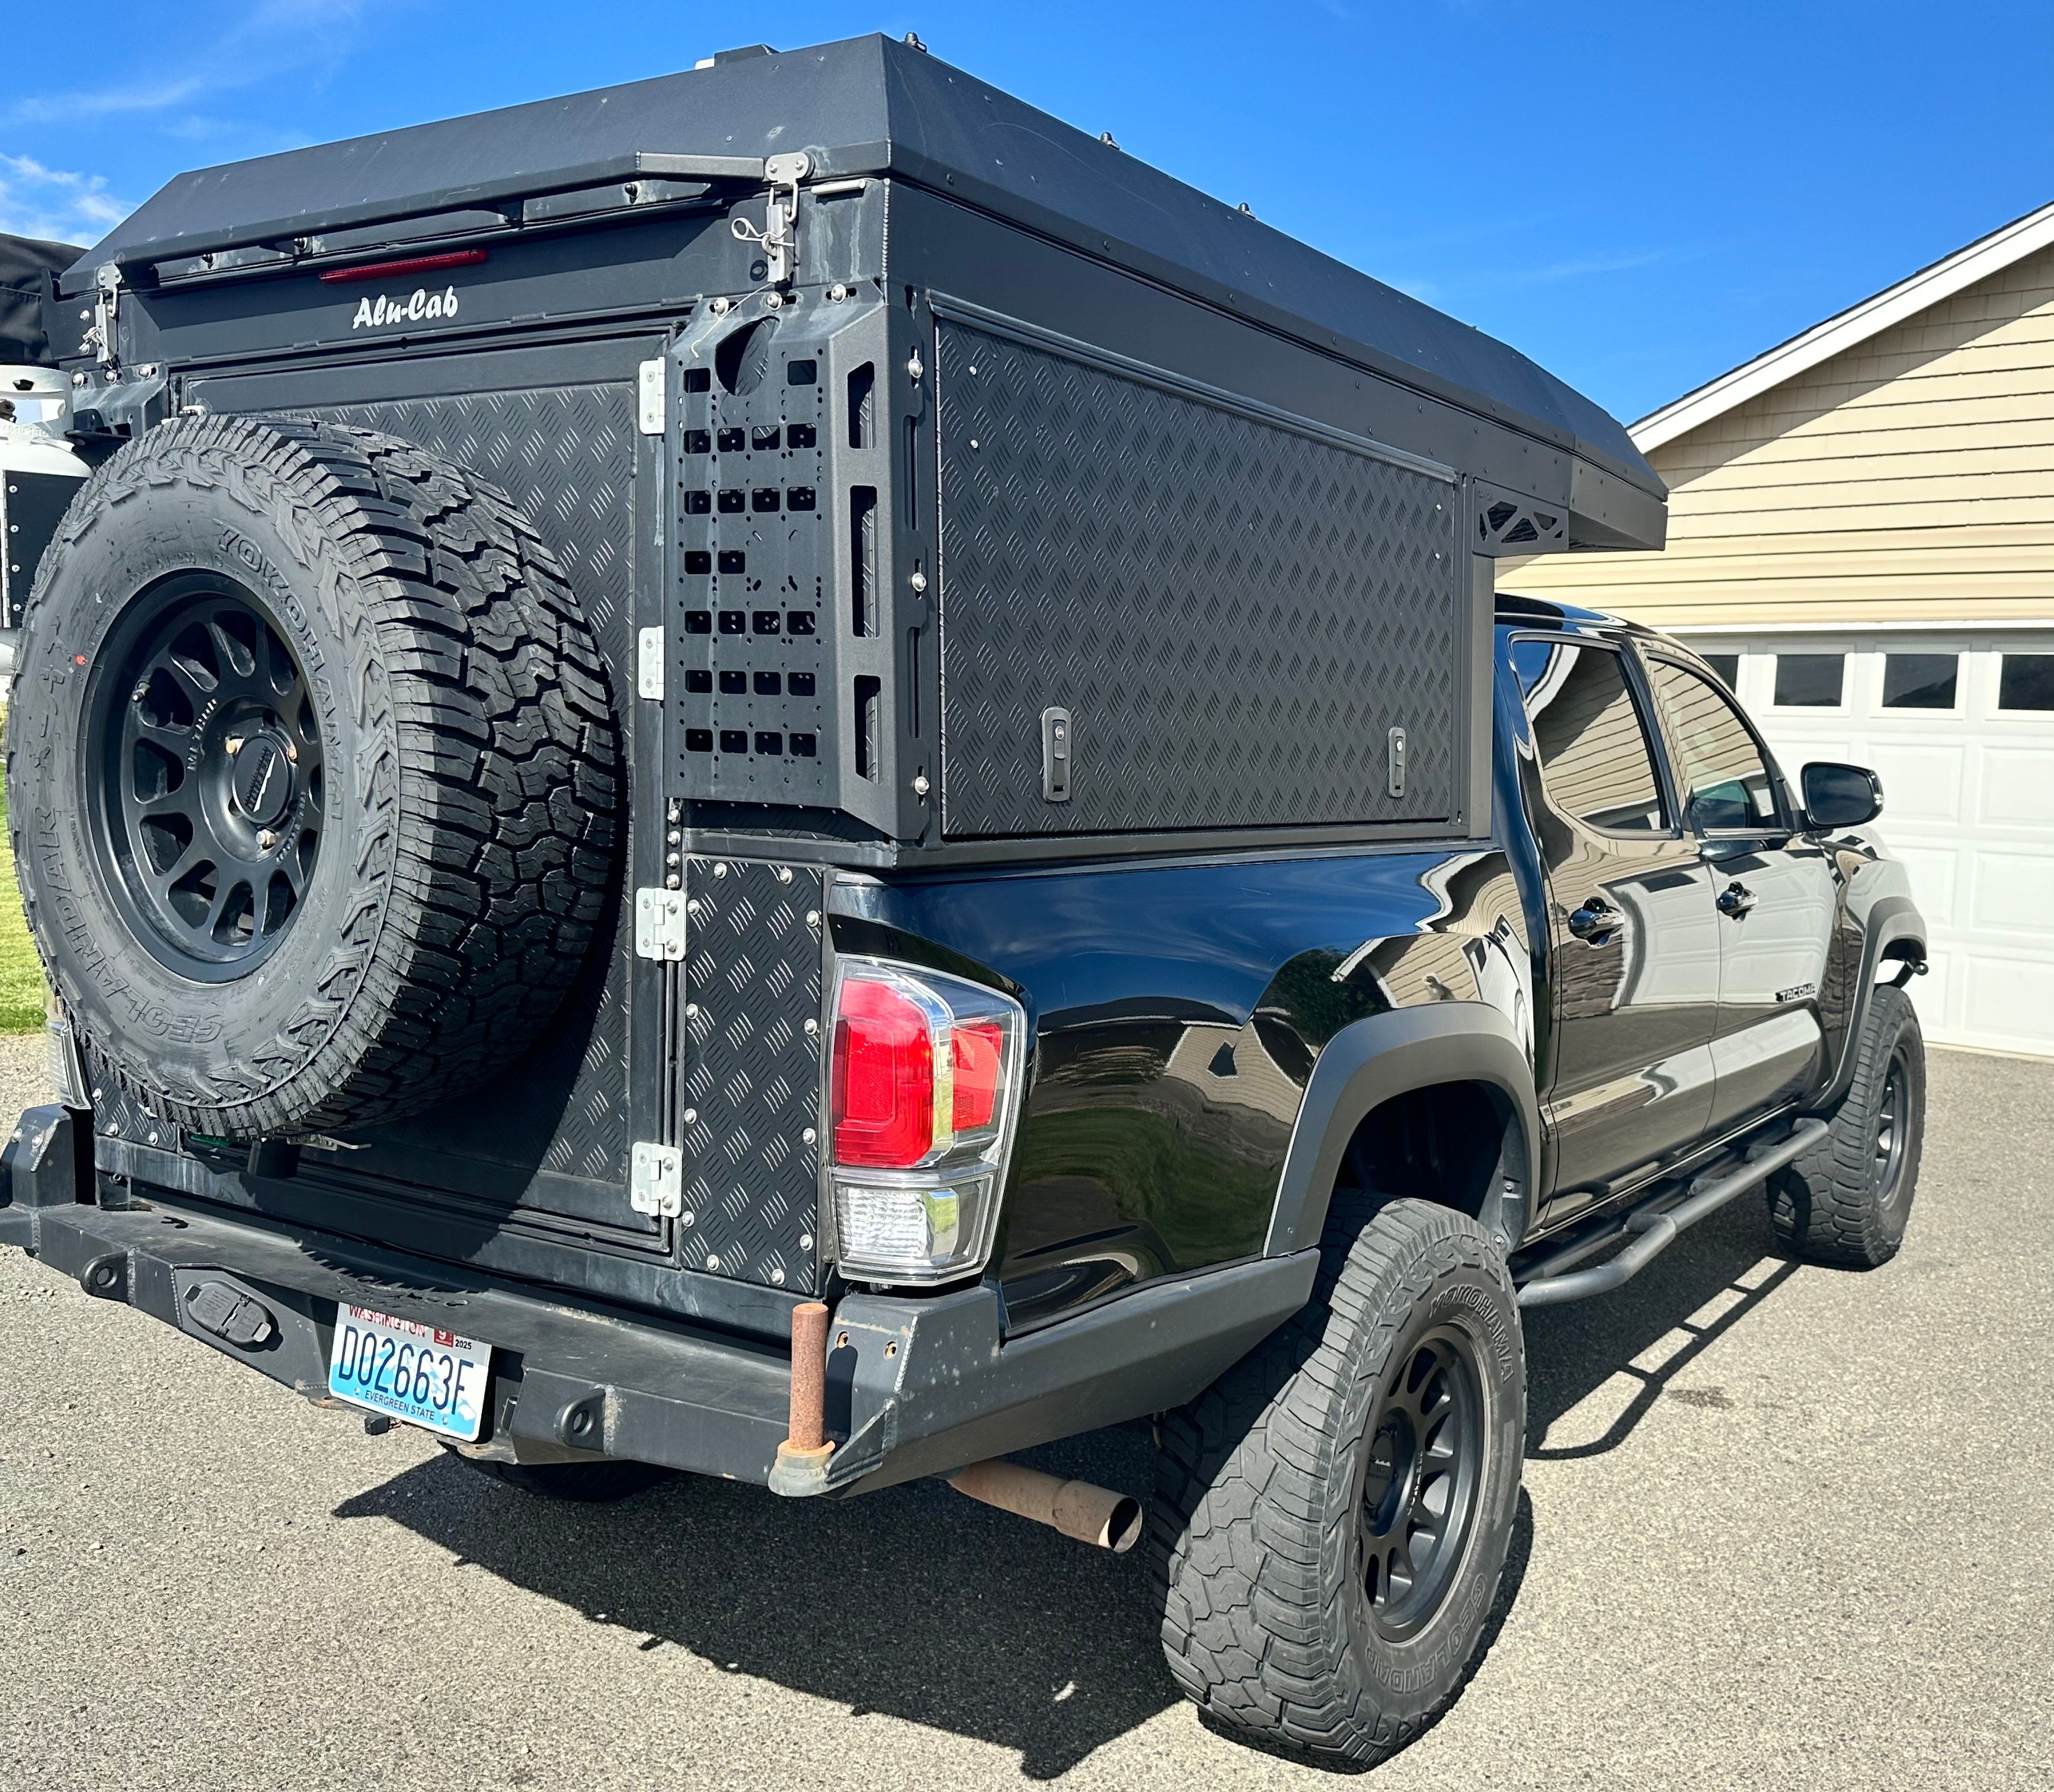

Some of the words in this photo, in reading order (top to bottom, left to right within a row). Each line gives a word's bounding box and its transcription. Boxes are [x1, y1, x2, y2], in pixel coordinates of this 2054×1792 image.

[353, 286, 458, 329] Alu-Cab
[212, 518, 344, 820] YOKOHAMA
[34, 807, 223, 1044] GEOLANDAR
[1778, 983, 1816, 1001] TACOMA
[338, 1325, 474, 1415] D02663F
[348, 1305, 425, 1337] WASHINGTON
[455, 1339, 472, 1350] 2025
[1428, 1284, 1514, 1384] YOKOHAMA
[364, 1390, 409, 1415] EVERGREEN
[410, 1404, 436, 1420] STATE
[1365, 1573, 1486, 1695] GEOLANDAR
